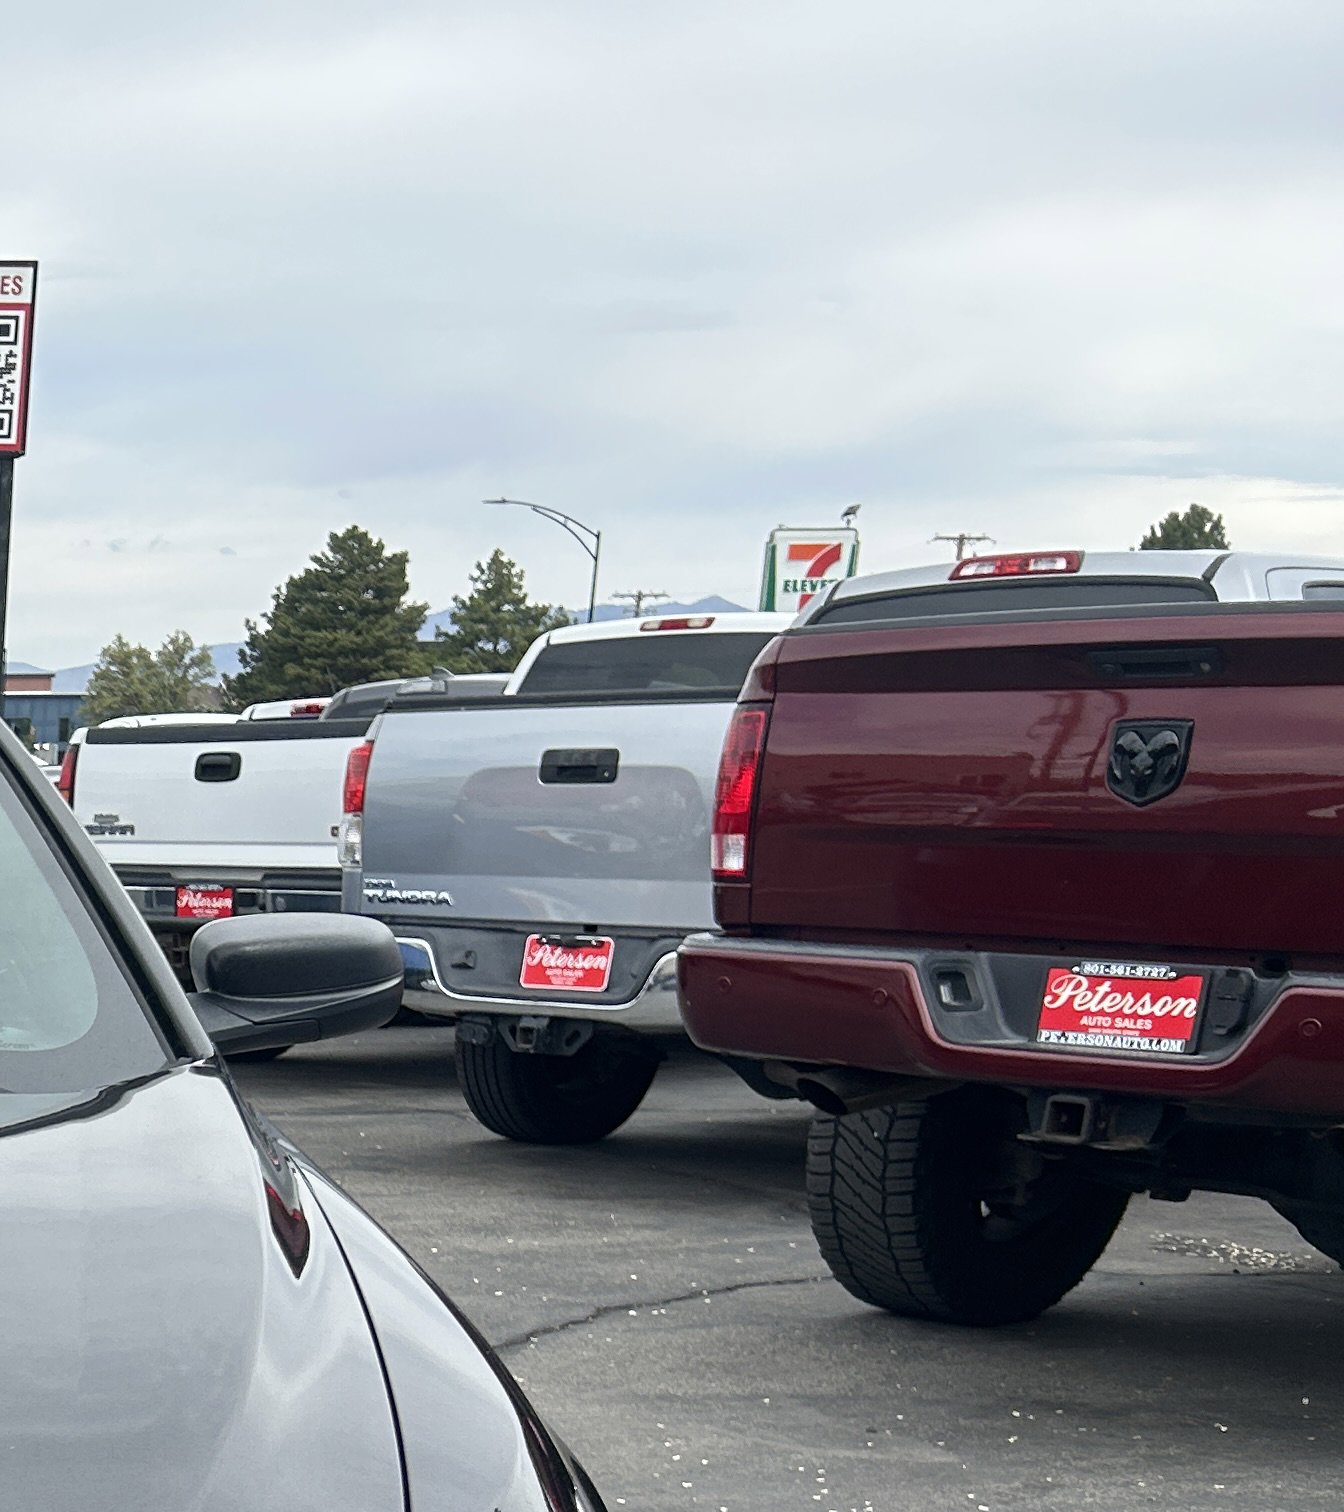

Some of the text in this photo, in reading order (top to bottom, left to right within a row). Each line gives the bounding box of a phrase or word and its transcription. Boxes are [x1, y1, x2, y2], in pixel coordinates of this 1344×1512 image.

[363, 888, 454, 905] TUNDRA
[525, 943, 608, 971] Peterson
[1043, 973, 1197, 1019] Peterson
[1079, 1015, 1153, 1030] AUTO SALES
